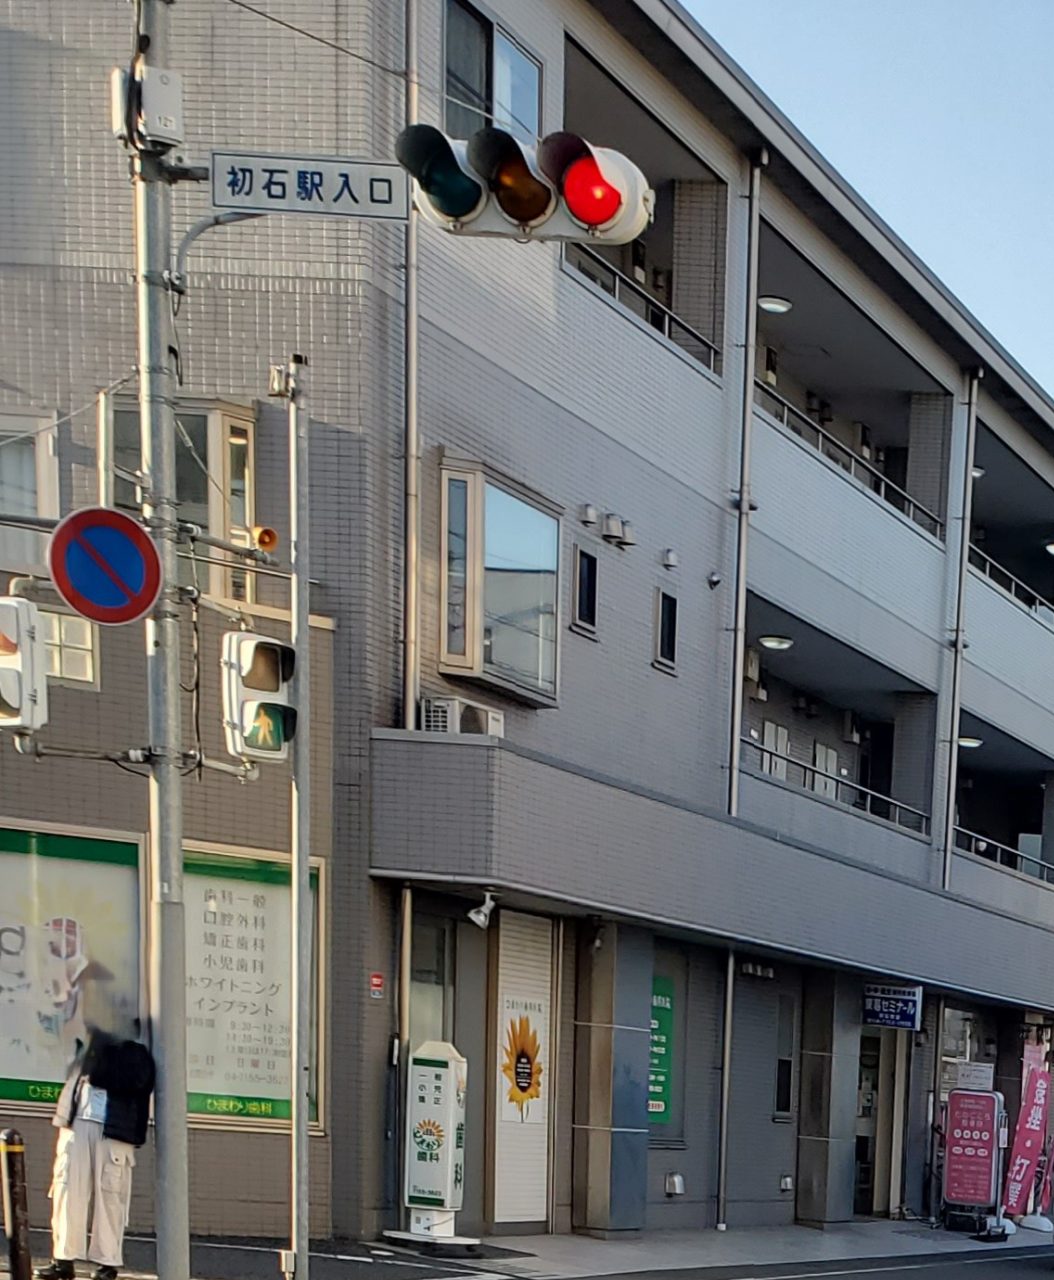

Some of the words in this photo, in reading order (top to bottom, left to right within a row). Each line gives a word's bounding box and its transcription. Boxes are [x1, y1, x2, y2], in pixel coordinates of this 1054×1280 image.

[227, 165, 393, 205] 初石駅入口
[204, 932, 265, 952] 矯正歯科
[203, 953, 264, 974] 小児歯科
[195, 997, 273, 1016] インプラント
